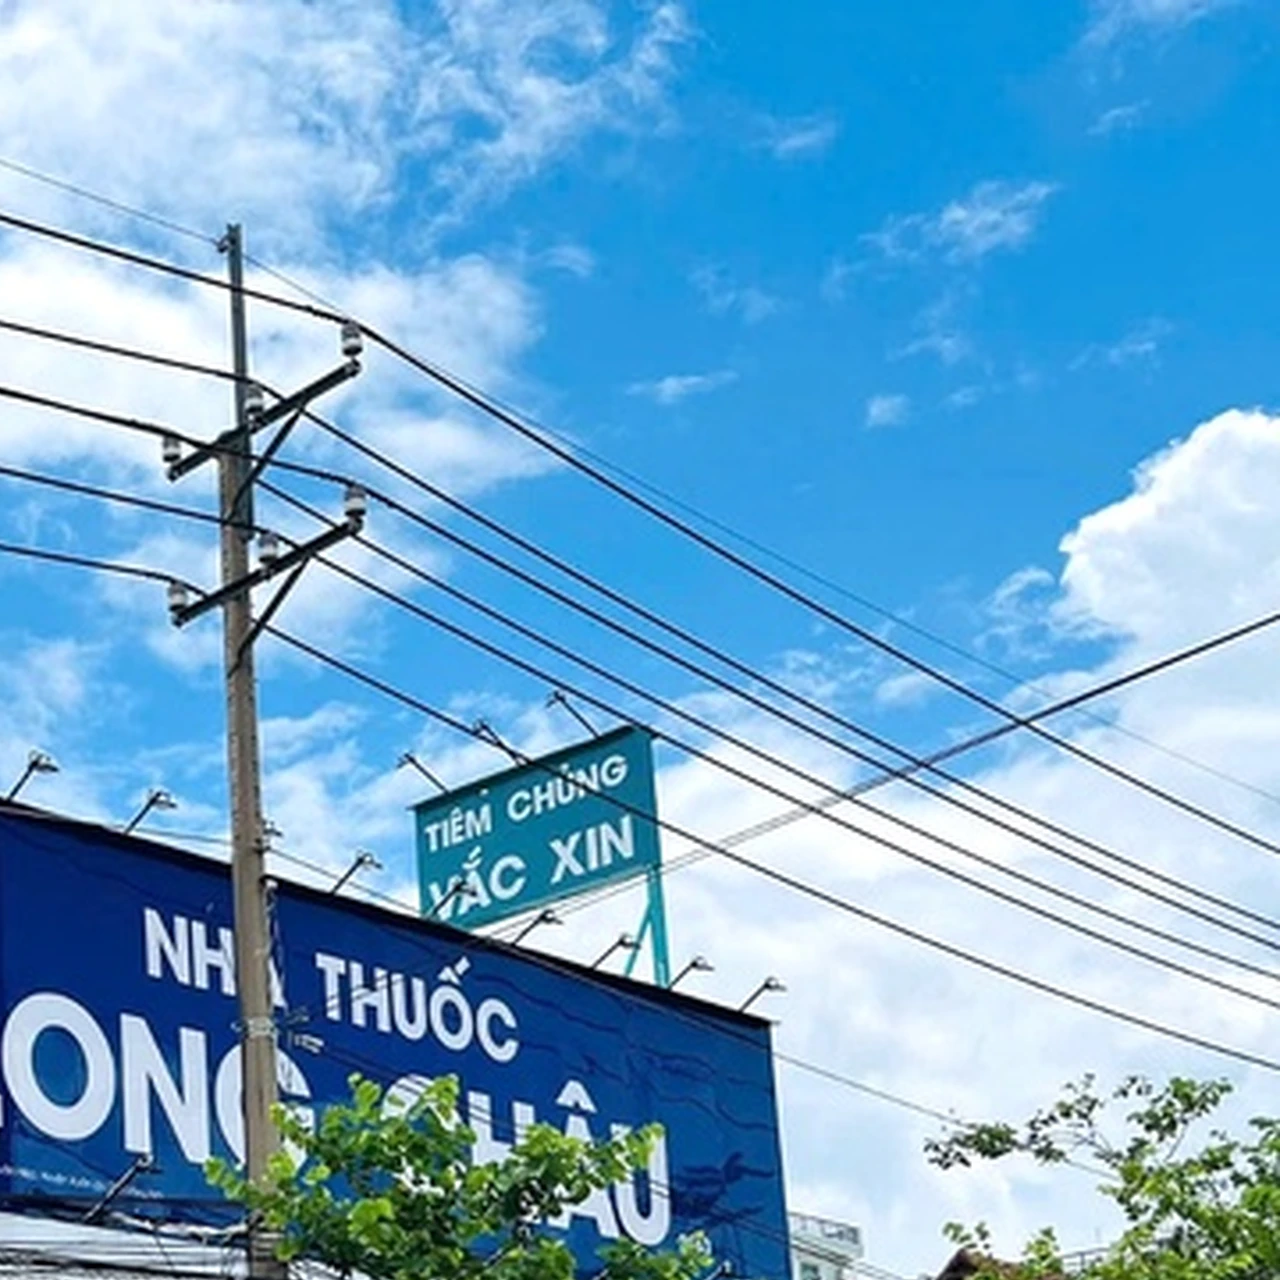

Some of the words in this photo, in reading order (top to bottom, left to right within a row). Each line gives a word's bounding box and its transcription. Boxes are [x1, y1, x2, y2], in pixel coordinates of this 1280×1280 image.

[424, 803, 492, 852] TIÊM
[428, 845, 527, 920] VẮC
[549, 813, 635, 884] XIN
[314, 956, 519, 1063] THUỐC
